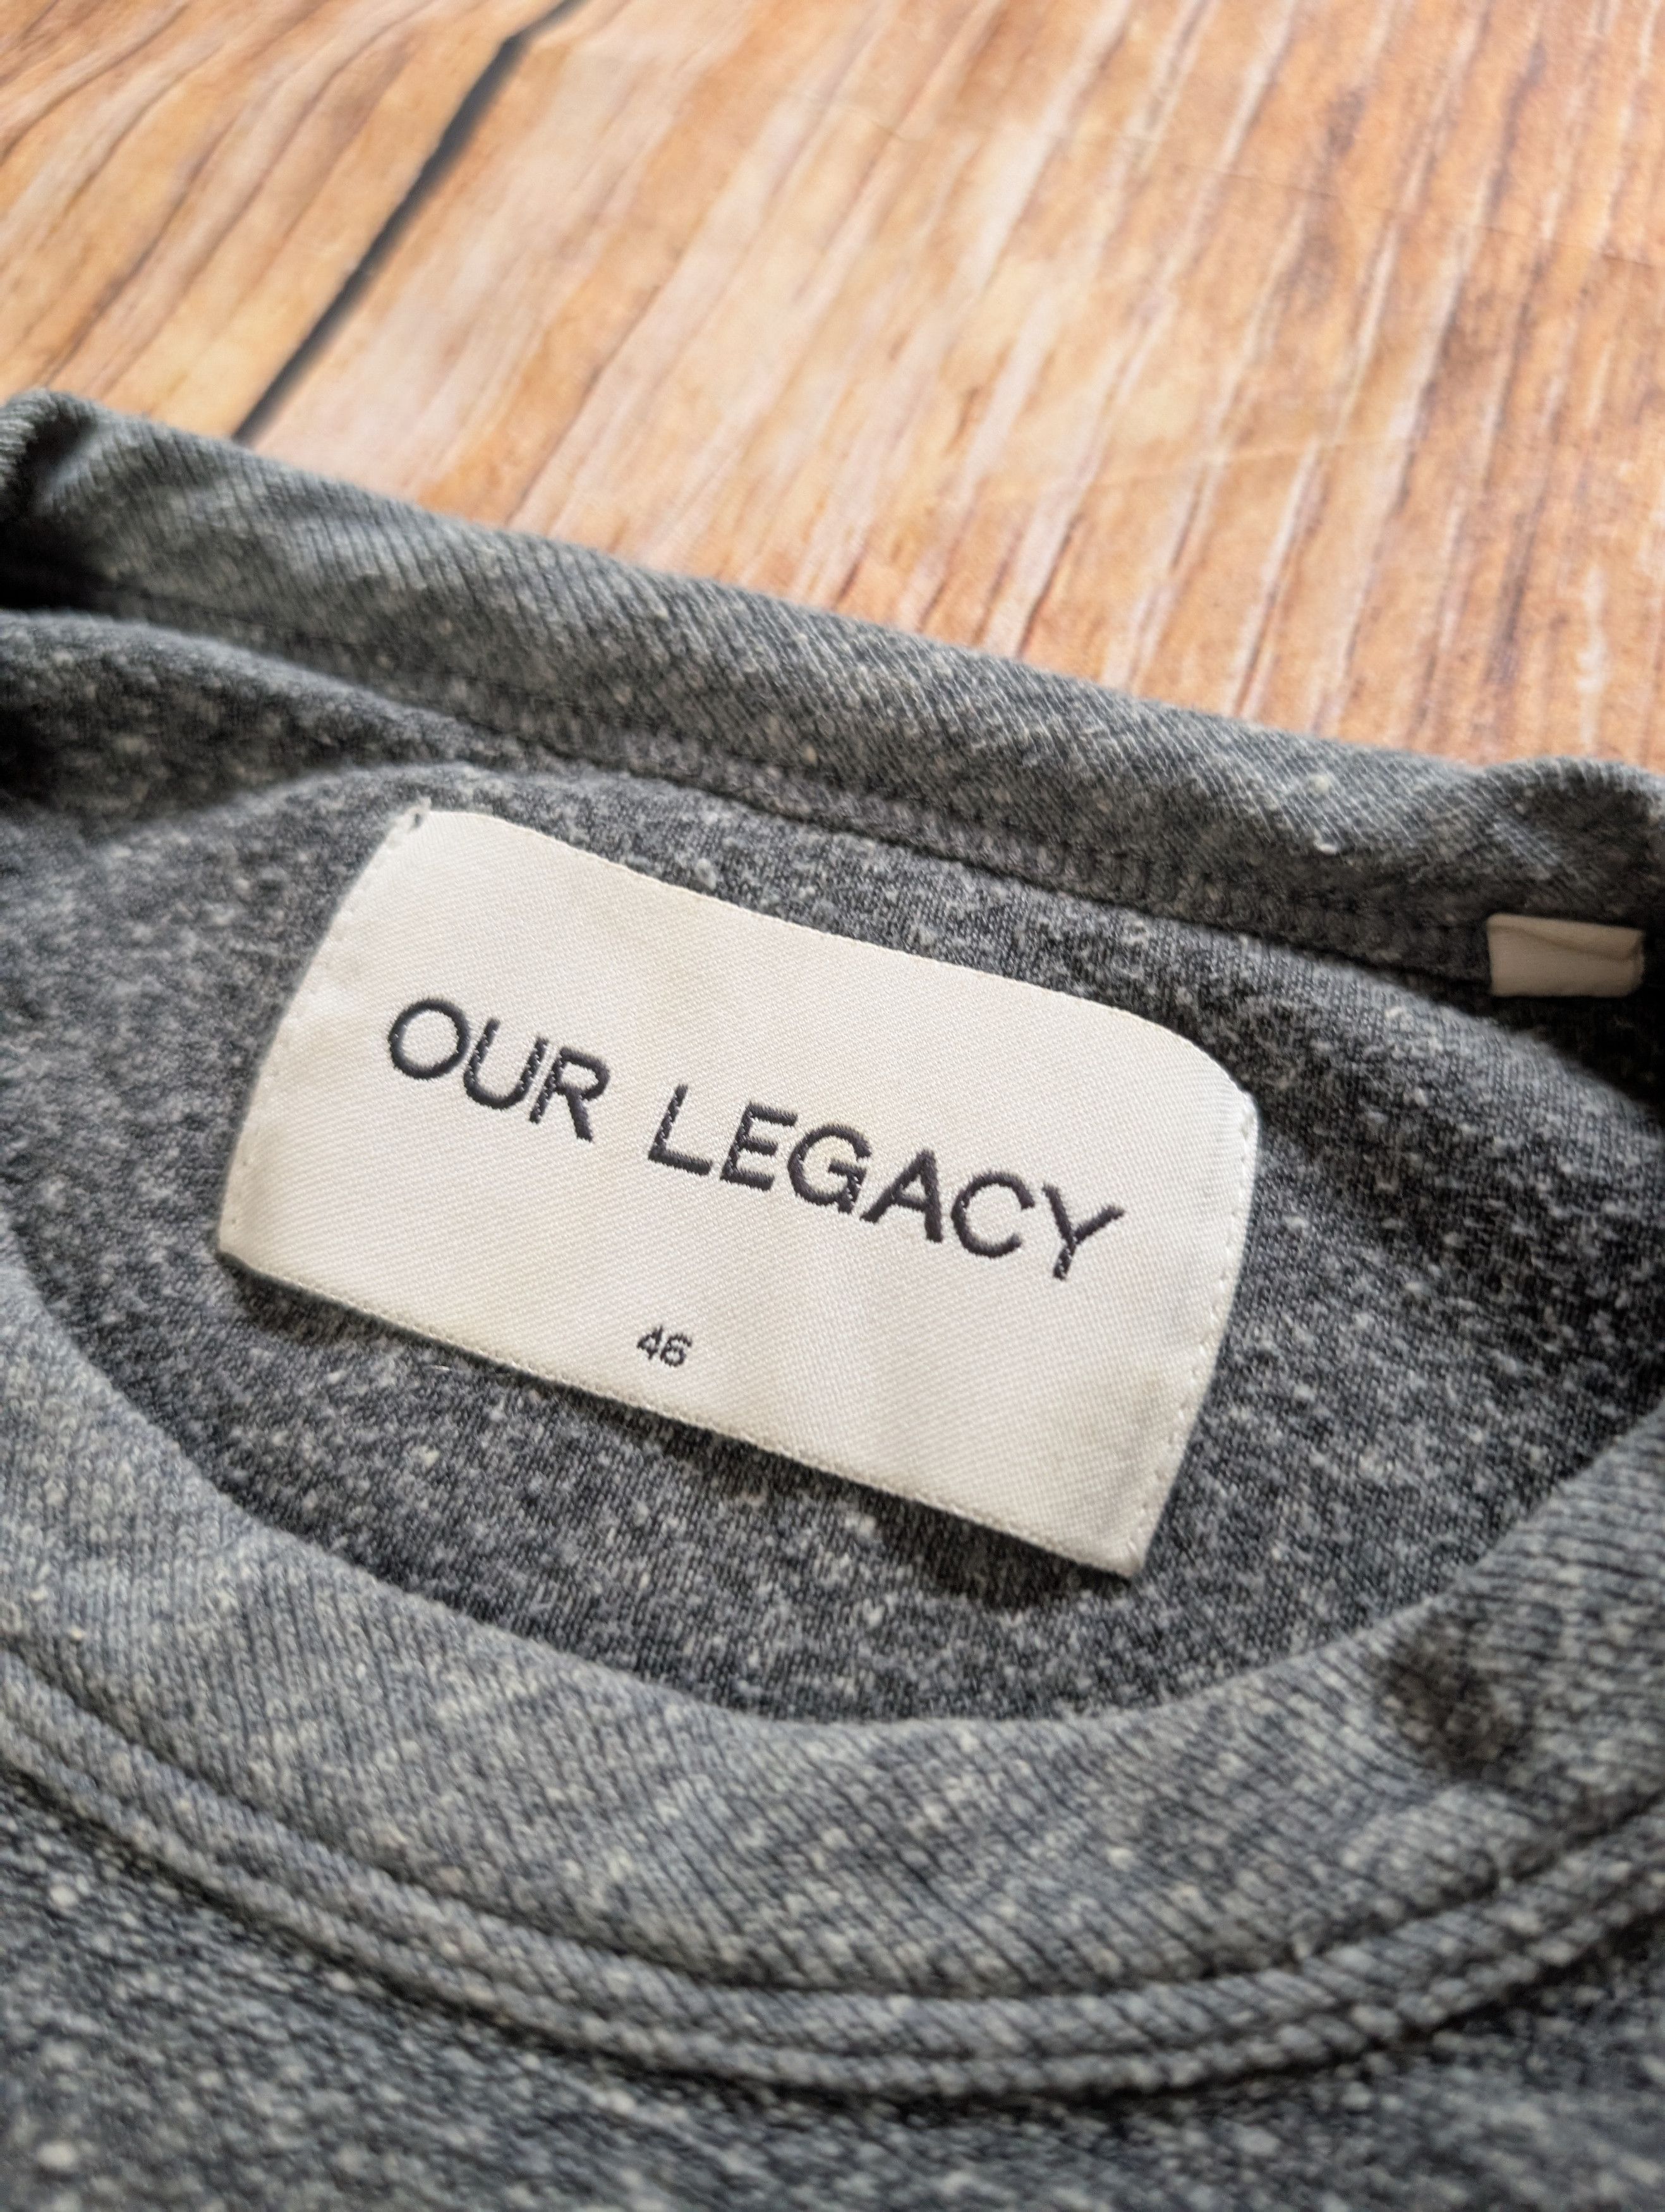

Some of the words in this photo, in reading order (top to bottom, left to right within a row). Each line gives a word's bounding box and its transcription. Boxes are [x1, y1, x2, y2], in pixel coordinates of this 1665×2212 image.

[387, 997, 610, 1142] OUR
[647, 1083, 1124, 1281] LEGACY
[636, 1325, 693, 1368] 46
